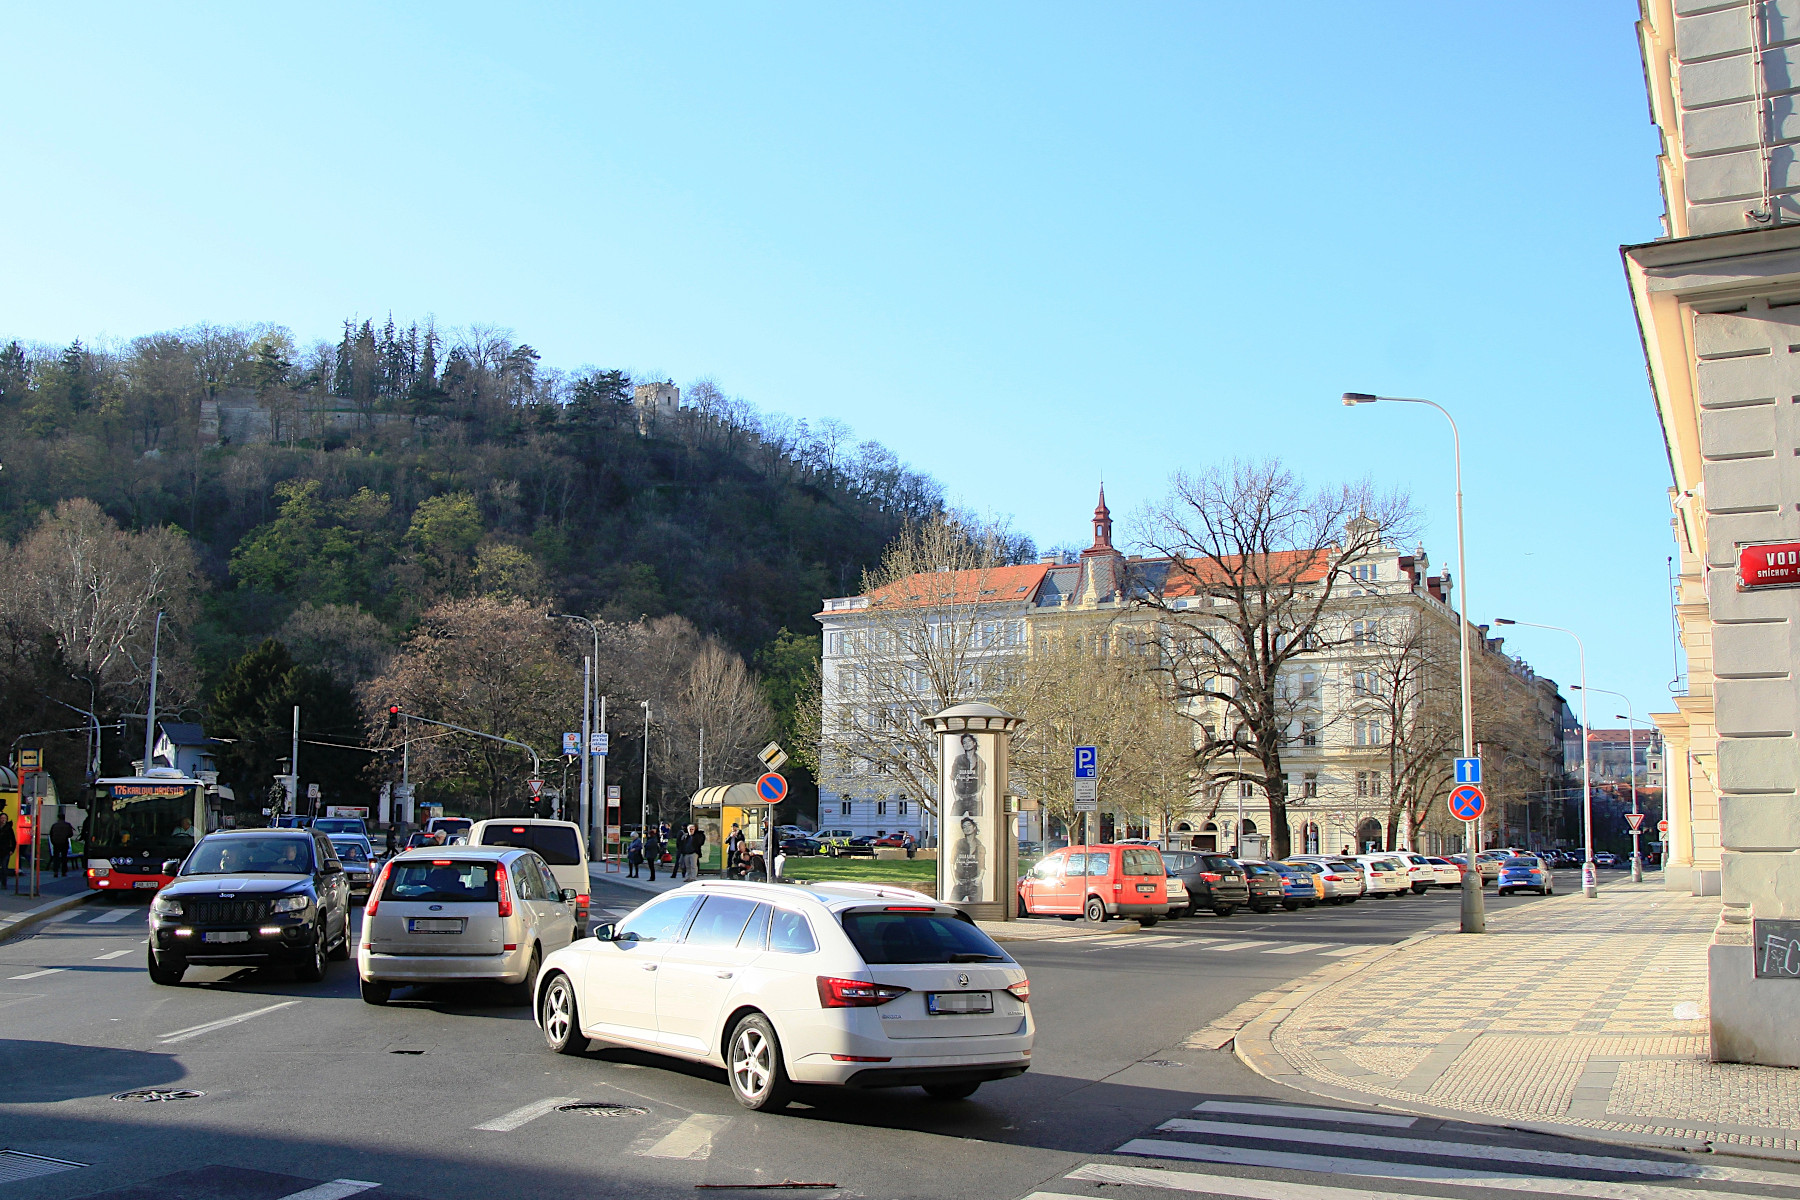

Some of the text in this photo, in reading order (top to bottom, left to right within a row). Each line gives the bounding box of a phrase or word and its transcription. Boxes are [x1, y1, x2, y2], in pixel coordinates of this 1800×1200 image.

[1766, 551, 1800, 566] VOD
[1757, 568, 1789, 577] SMÍCHOV
[1079, 750, 1092, 769] P
[114, 785, 127, 795] 176
